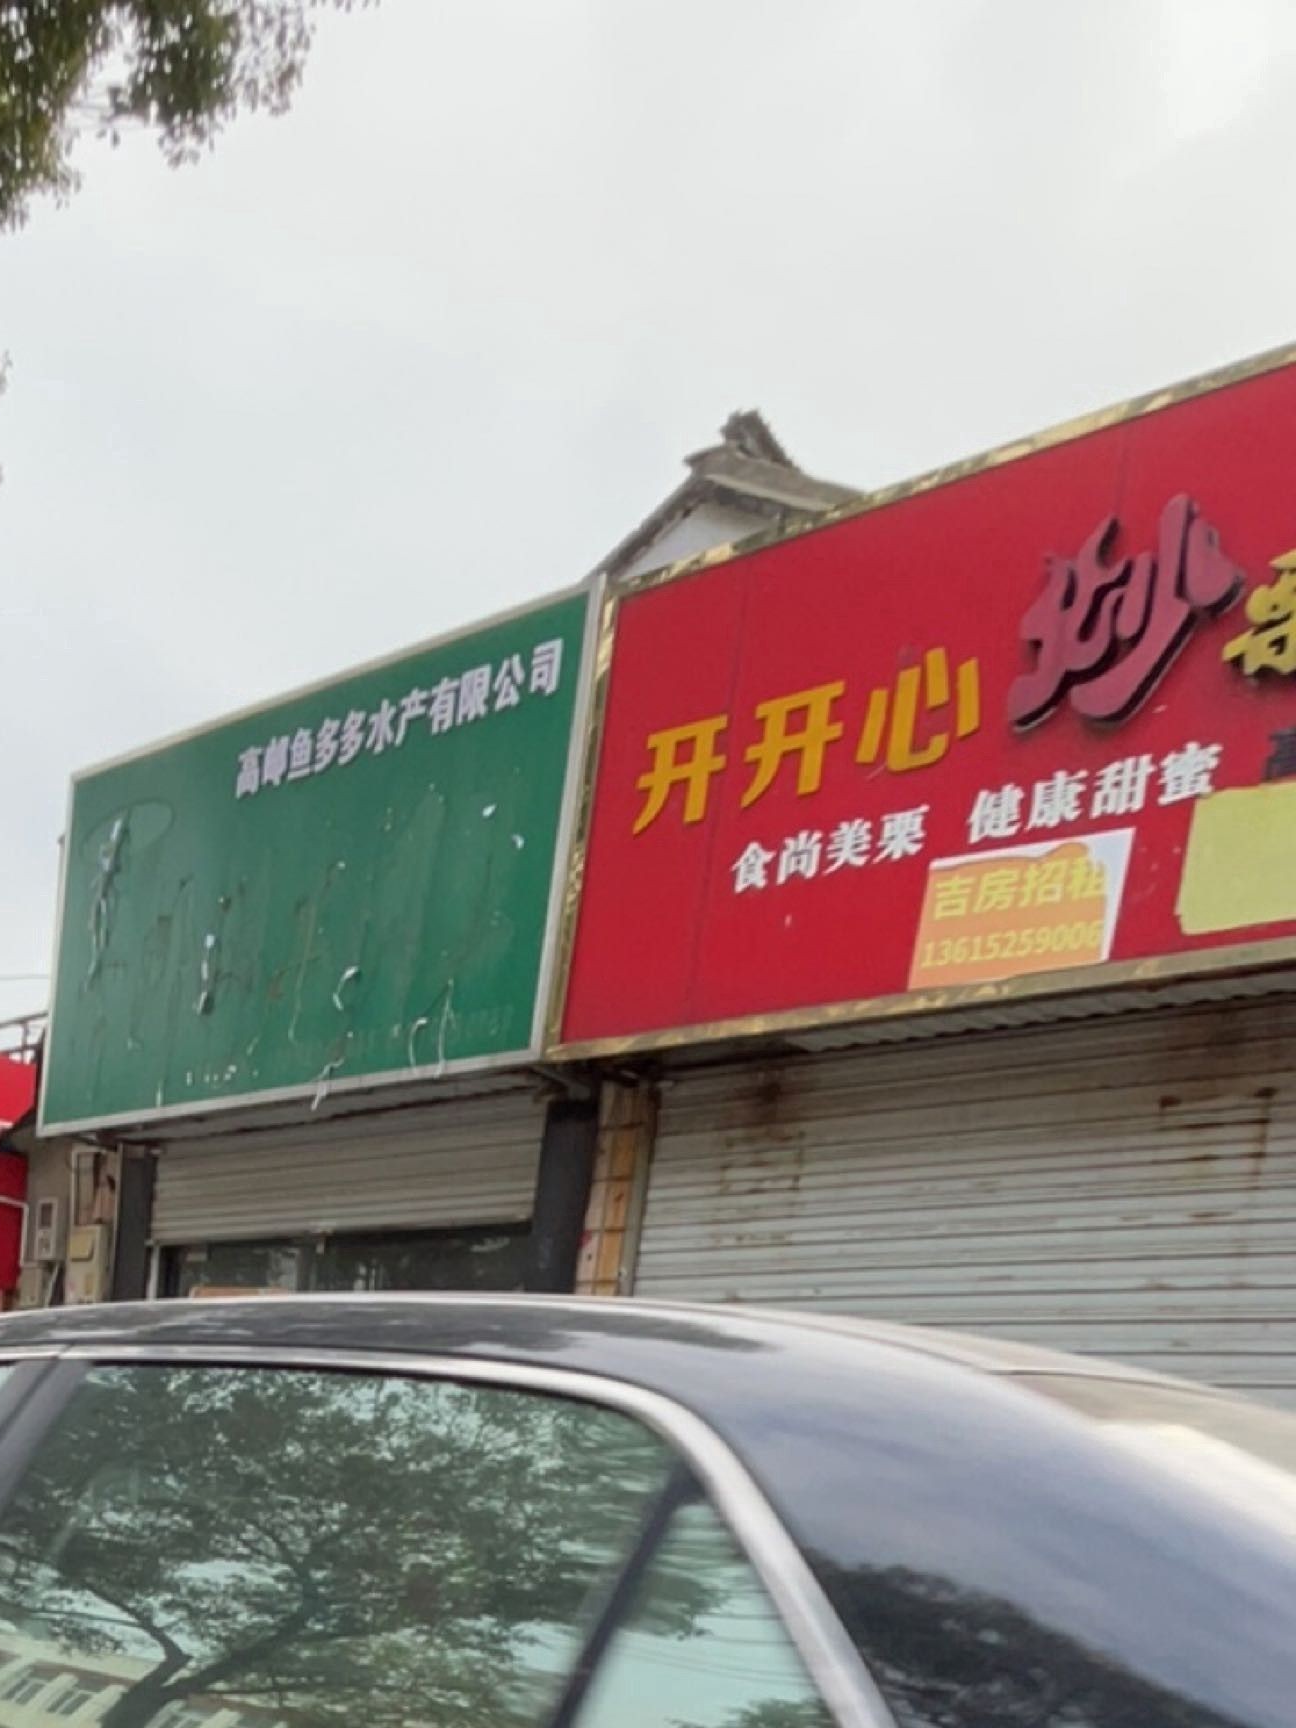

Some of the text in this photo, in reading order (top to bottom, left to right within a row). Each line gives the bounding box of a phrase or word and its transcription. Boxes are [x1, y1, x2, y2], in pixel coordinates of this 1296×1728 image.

[236, 638, 563, 799] 高邮鱼多多水产有限公司
[632, 647, 981, 834] 开开心
[731, 804, 930, 893] 食尚美栗
[966, 742, 1222, 844] 健康甜蜜
[934, 857, 1108, 920] 吉房招租
